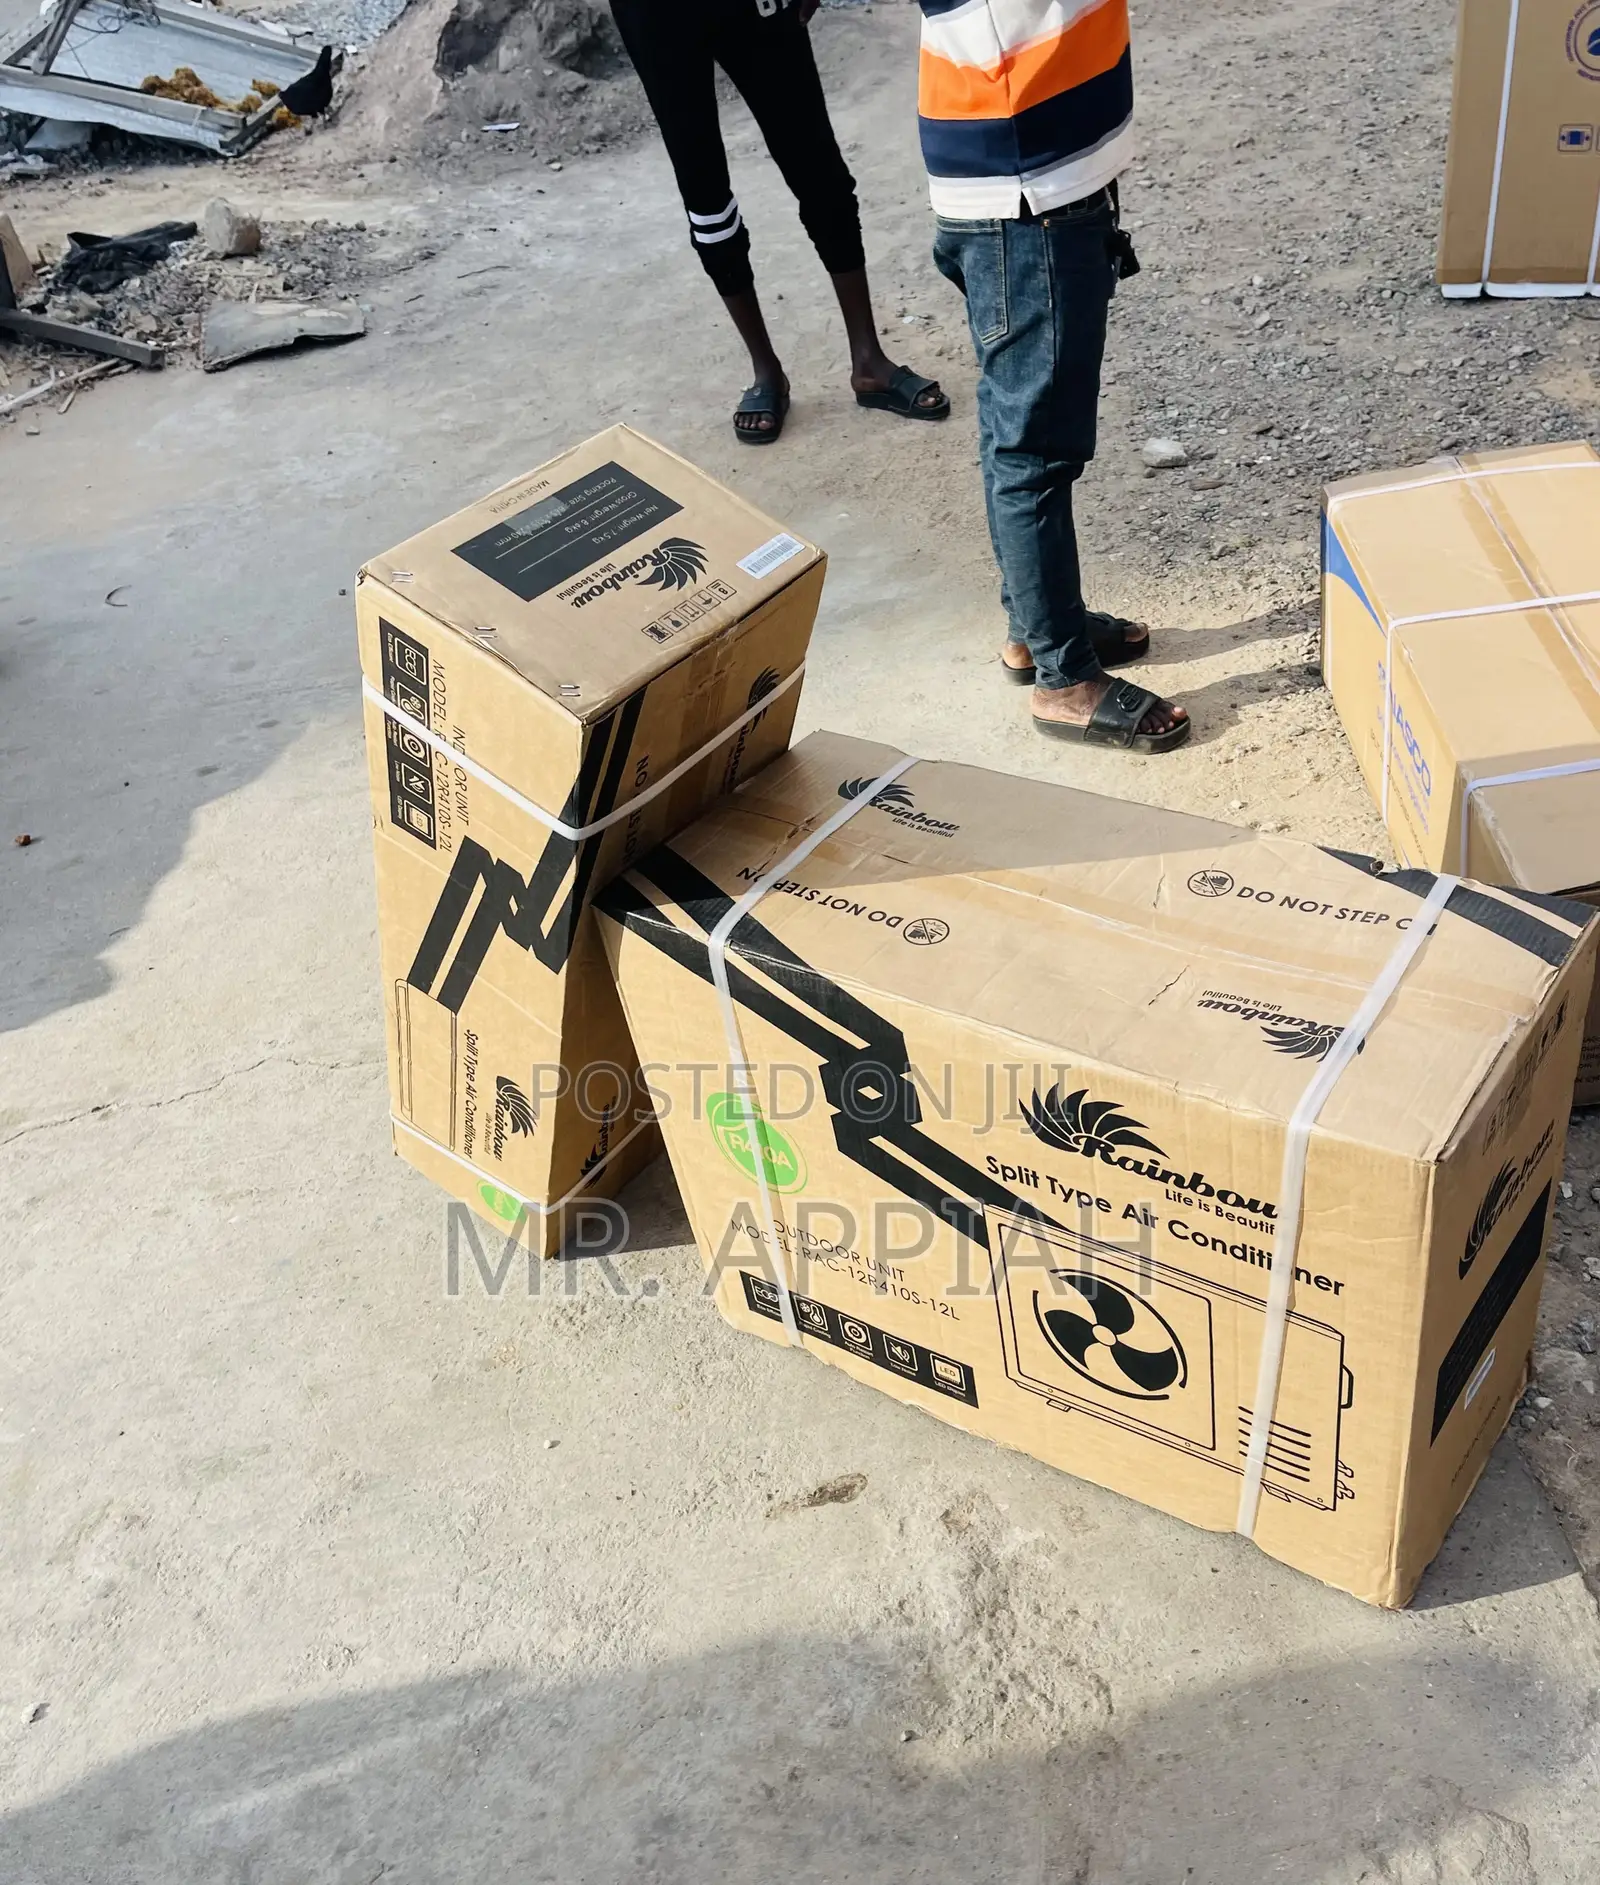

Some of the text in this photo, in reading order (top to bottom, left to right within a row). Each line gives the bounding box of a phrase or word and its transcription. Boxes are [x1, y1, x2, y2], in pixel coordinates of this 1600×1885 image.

[569, 547, 671, 609] Rainbow
[599, 562, 616, 575] Life
[556, 577, 592, 600] Beautiful
[434, 728, 453, 853] RC-12R410S-12L
[453, 725, 470, 827] INDOR UNIT
[869, 796, 960, 832] Rainbow
[892, 817, 908, 827] Life
[915, 823, 954, 838] Beautiful
[772, 879, 821, 902] STEP
[817, 894, 867, 916] NOT
[1236, 886, 1275, 903] DO
[1279, 895, 1333, 916] NOT
[1334, 907, 1390, 925] STEP
[868, 910, 904, 928] DO
[1202, 989, 1250, 1004] Beautiful
[1262, 1001, 1282, 1012] Life
[1197, 999, 1340, 1036] Rainbow
[463, 1029, 479, 1159] Split Type Air Conditioner
[494, 1090, 511, 1162] Rainbow
[986, 1155, 1345, 1297] Split Type Air Conditiner
[1165, 1188, 1275, 1236] Life is Beautif
[866, 1256, 905, 1283] UNIT
[939, 1365, 956, 1378] LED
